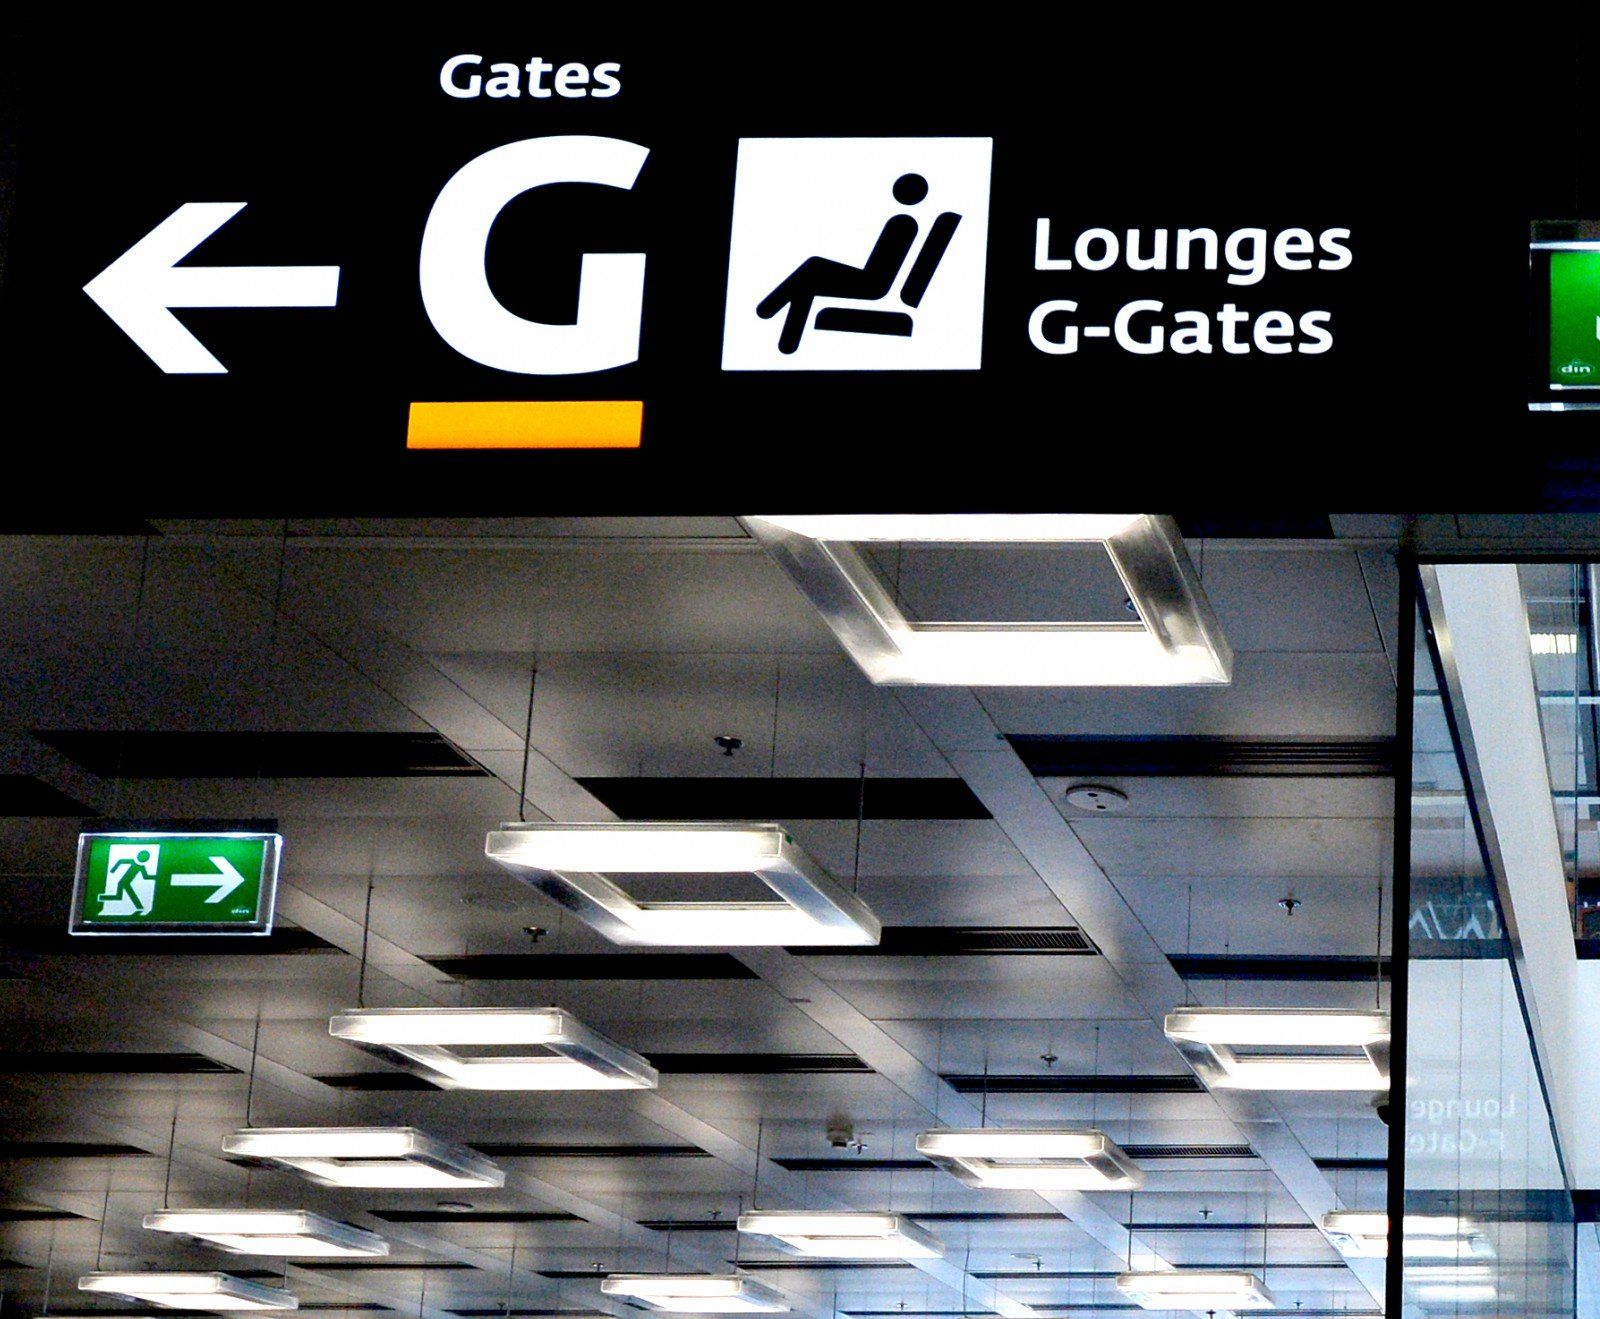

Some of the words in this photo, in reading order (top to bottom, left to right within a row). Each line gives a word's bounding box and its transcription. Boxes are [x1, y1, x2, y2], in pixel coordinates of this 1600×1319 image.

[439, 53, 621, 99] Gates
[419, 134, 651, 376] G
[1034, 217, 1353, 286] Lounges
[1028, 299, 1335, 355] G-Gates
[1561, 364, 1591, 373] din
